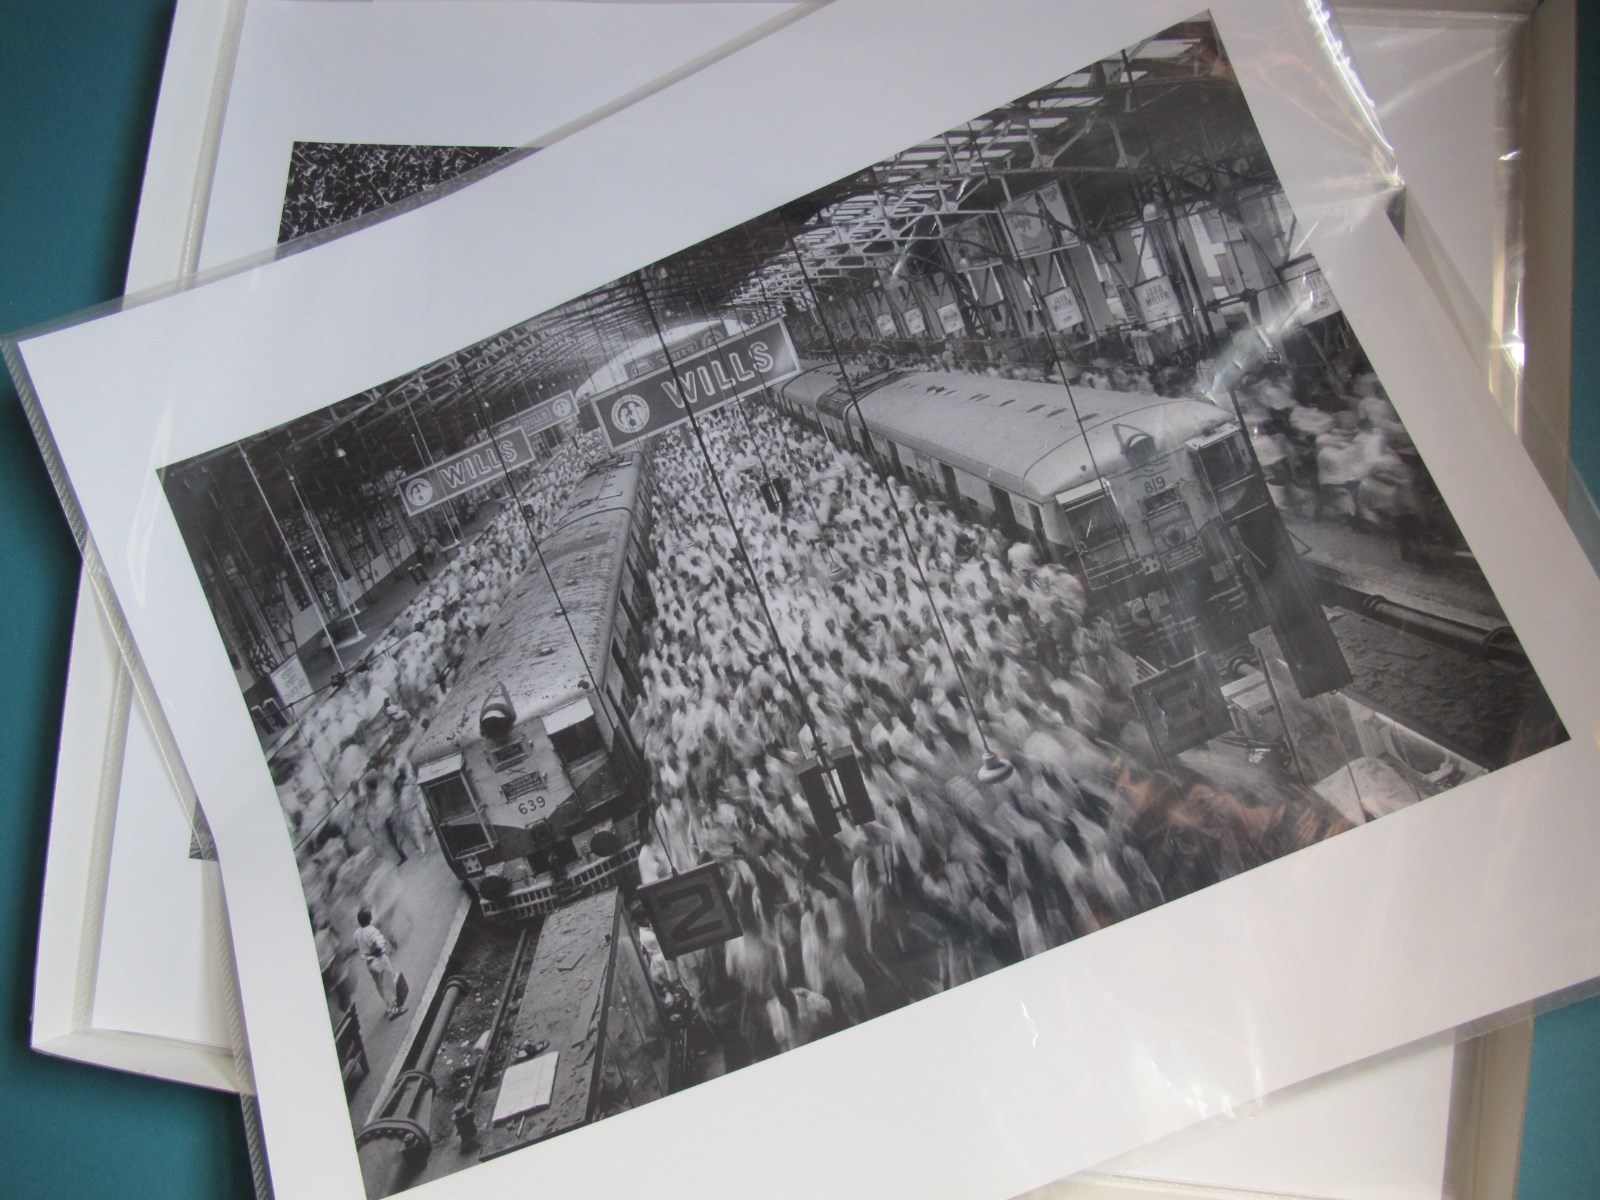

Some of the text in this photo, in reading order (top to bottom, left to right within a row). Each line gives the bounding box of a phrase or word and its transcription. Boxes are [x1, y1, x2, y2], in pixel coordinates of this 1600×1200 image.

[660, 341, 774, 409] WILLS
[439, 440, 518, 489] WILLS
[518, 796, 546, 815] 639
